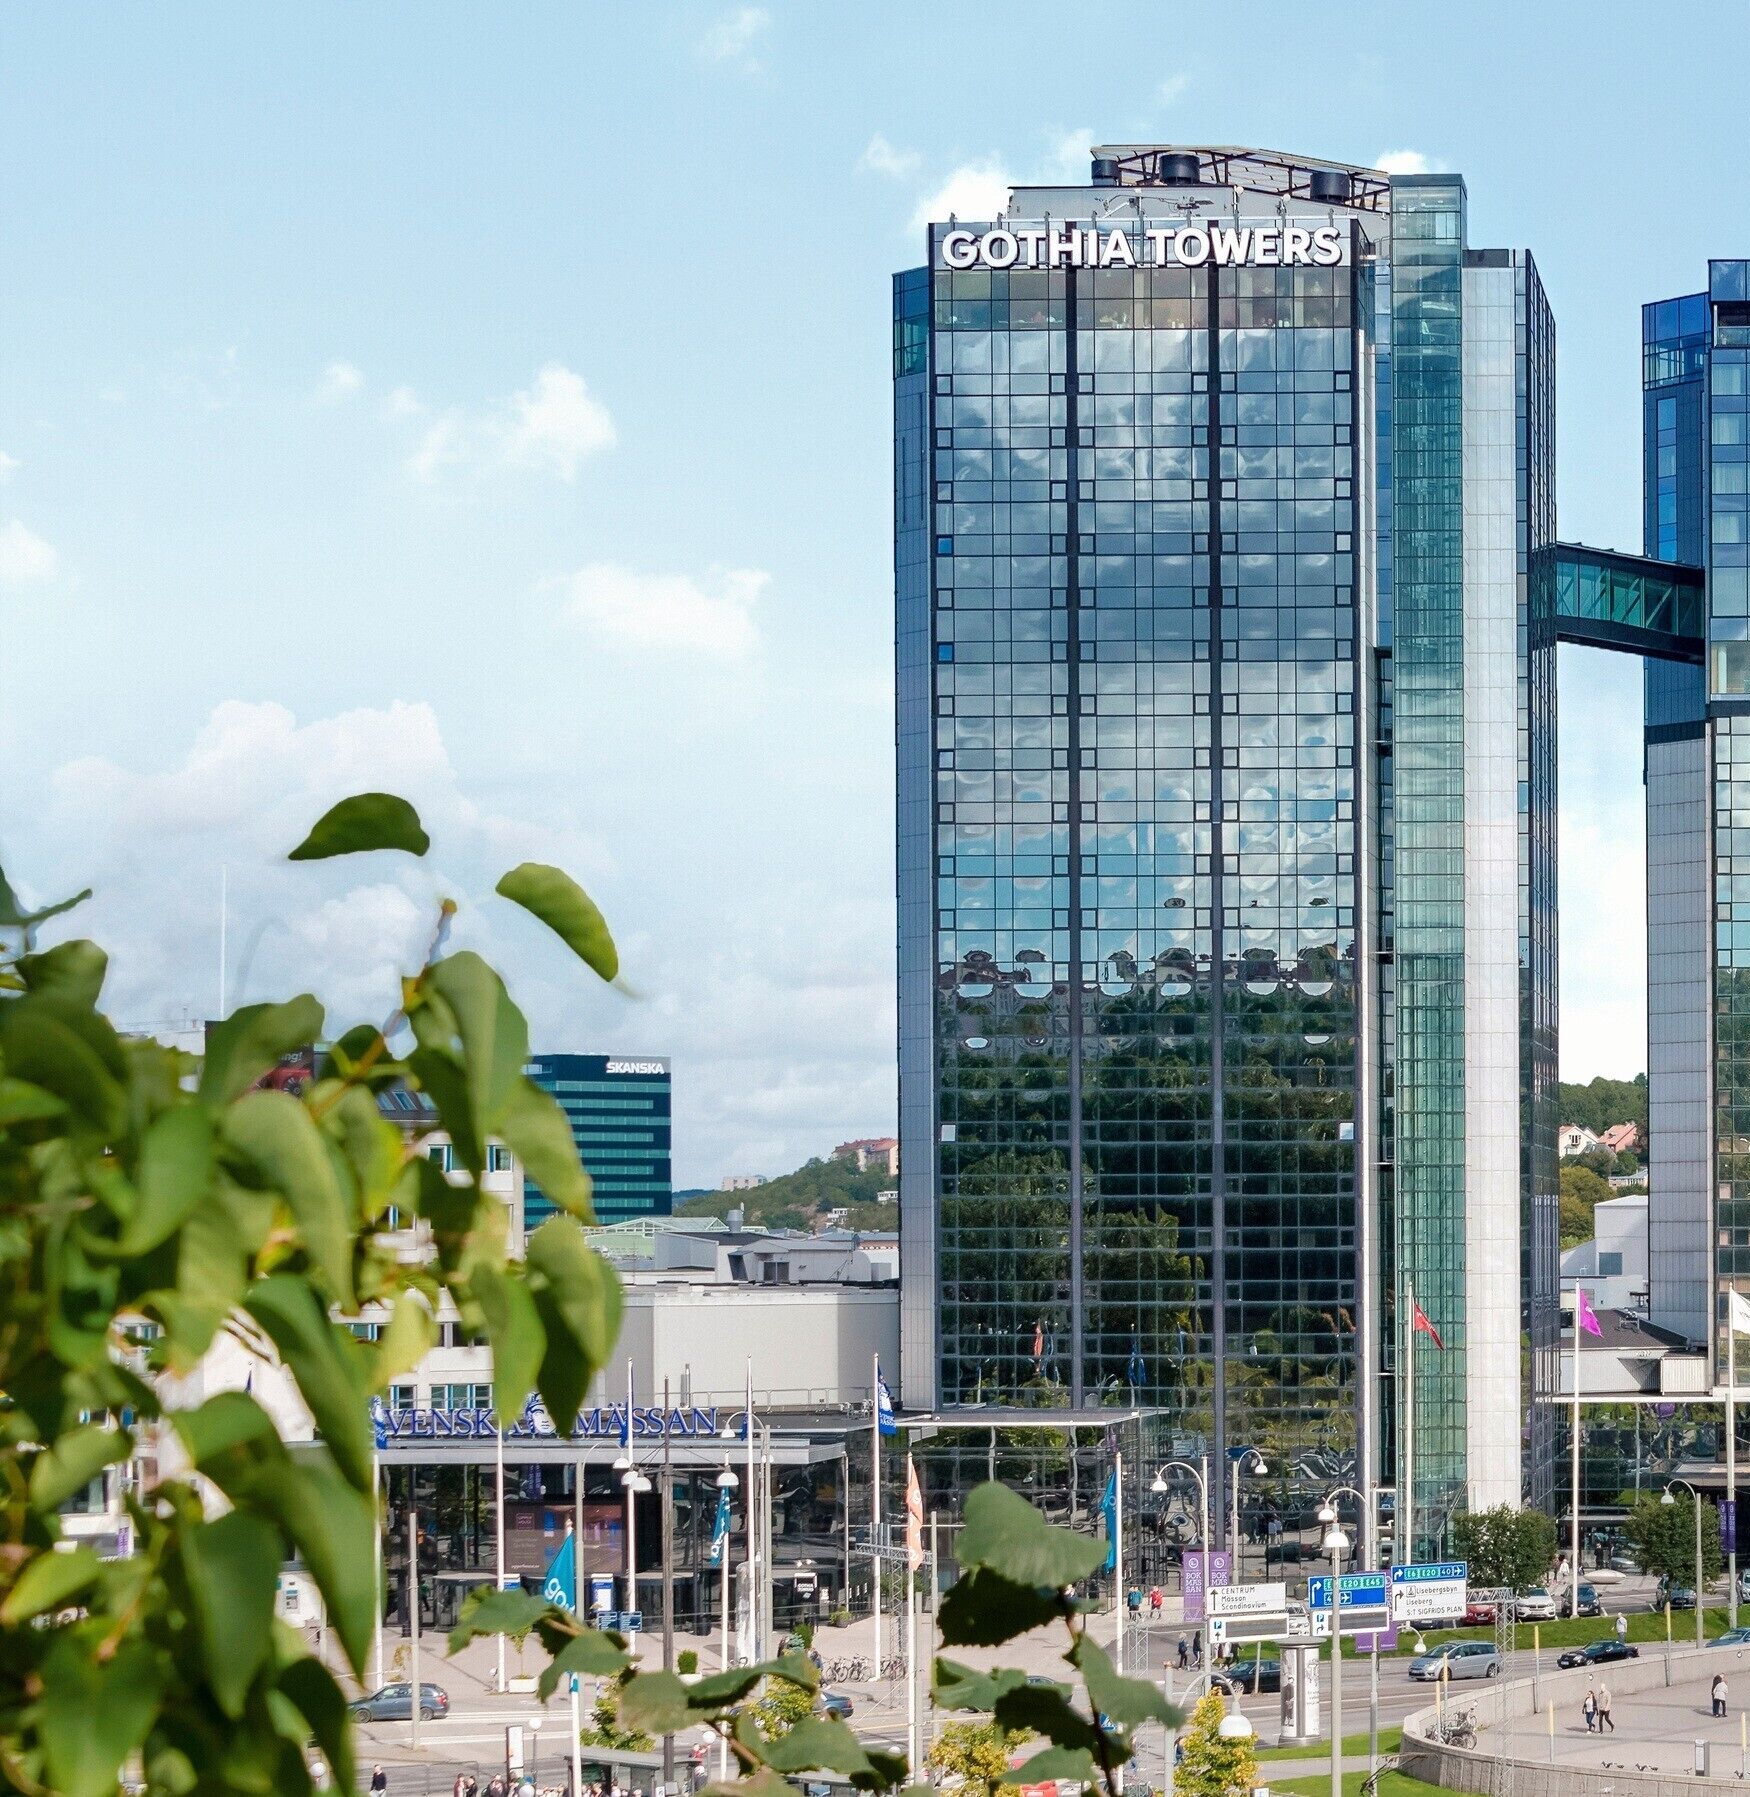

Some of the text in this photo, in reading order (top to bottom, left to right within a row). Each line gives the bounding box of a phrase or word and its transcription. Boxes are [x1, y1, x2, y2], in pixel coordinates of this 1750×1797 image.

[942, 226, 1344, 269] GOTHIA TOWERS
[605, 1062, 665, 1075] SKANSKA
[573, 1402, 720, 1436] MÄSSAN
[1422, 1569, 1436, 1577] E20
[1343, 1580, 1359, 1588] E20
[1365, 1578, 1381, 1587] E45
[1221, 1586, 1255, 1595] CENTRUM
[1416, 1586, 1458, 1595] Lisebergsbyn
[1406, 1598, 1433, 1606] Liseberg
[1417, 1607, 1445, 1615] SIGFRIDS
[1446, 1605, 1463, 1613] PLAN
